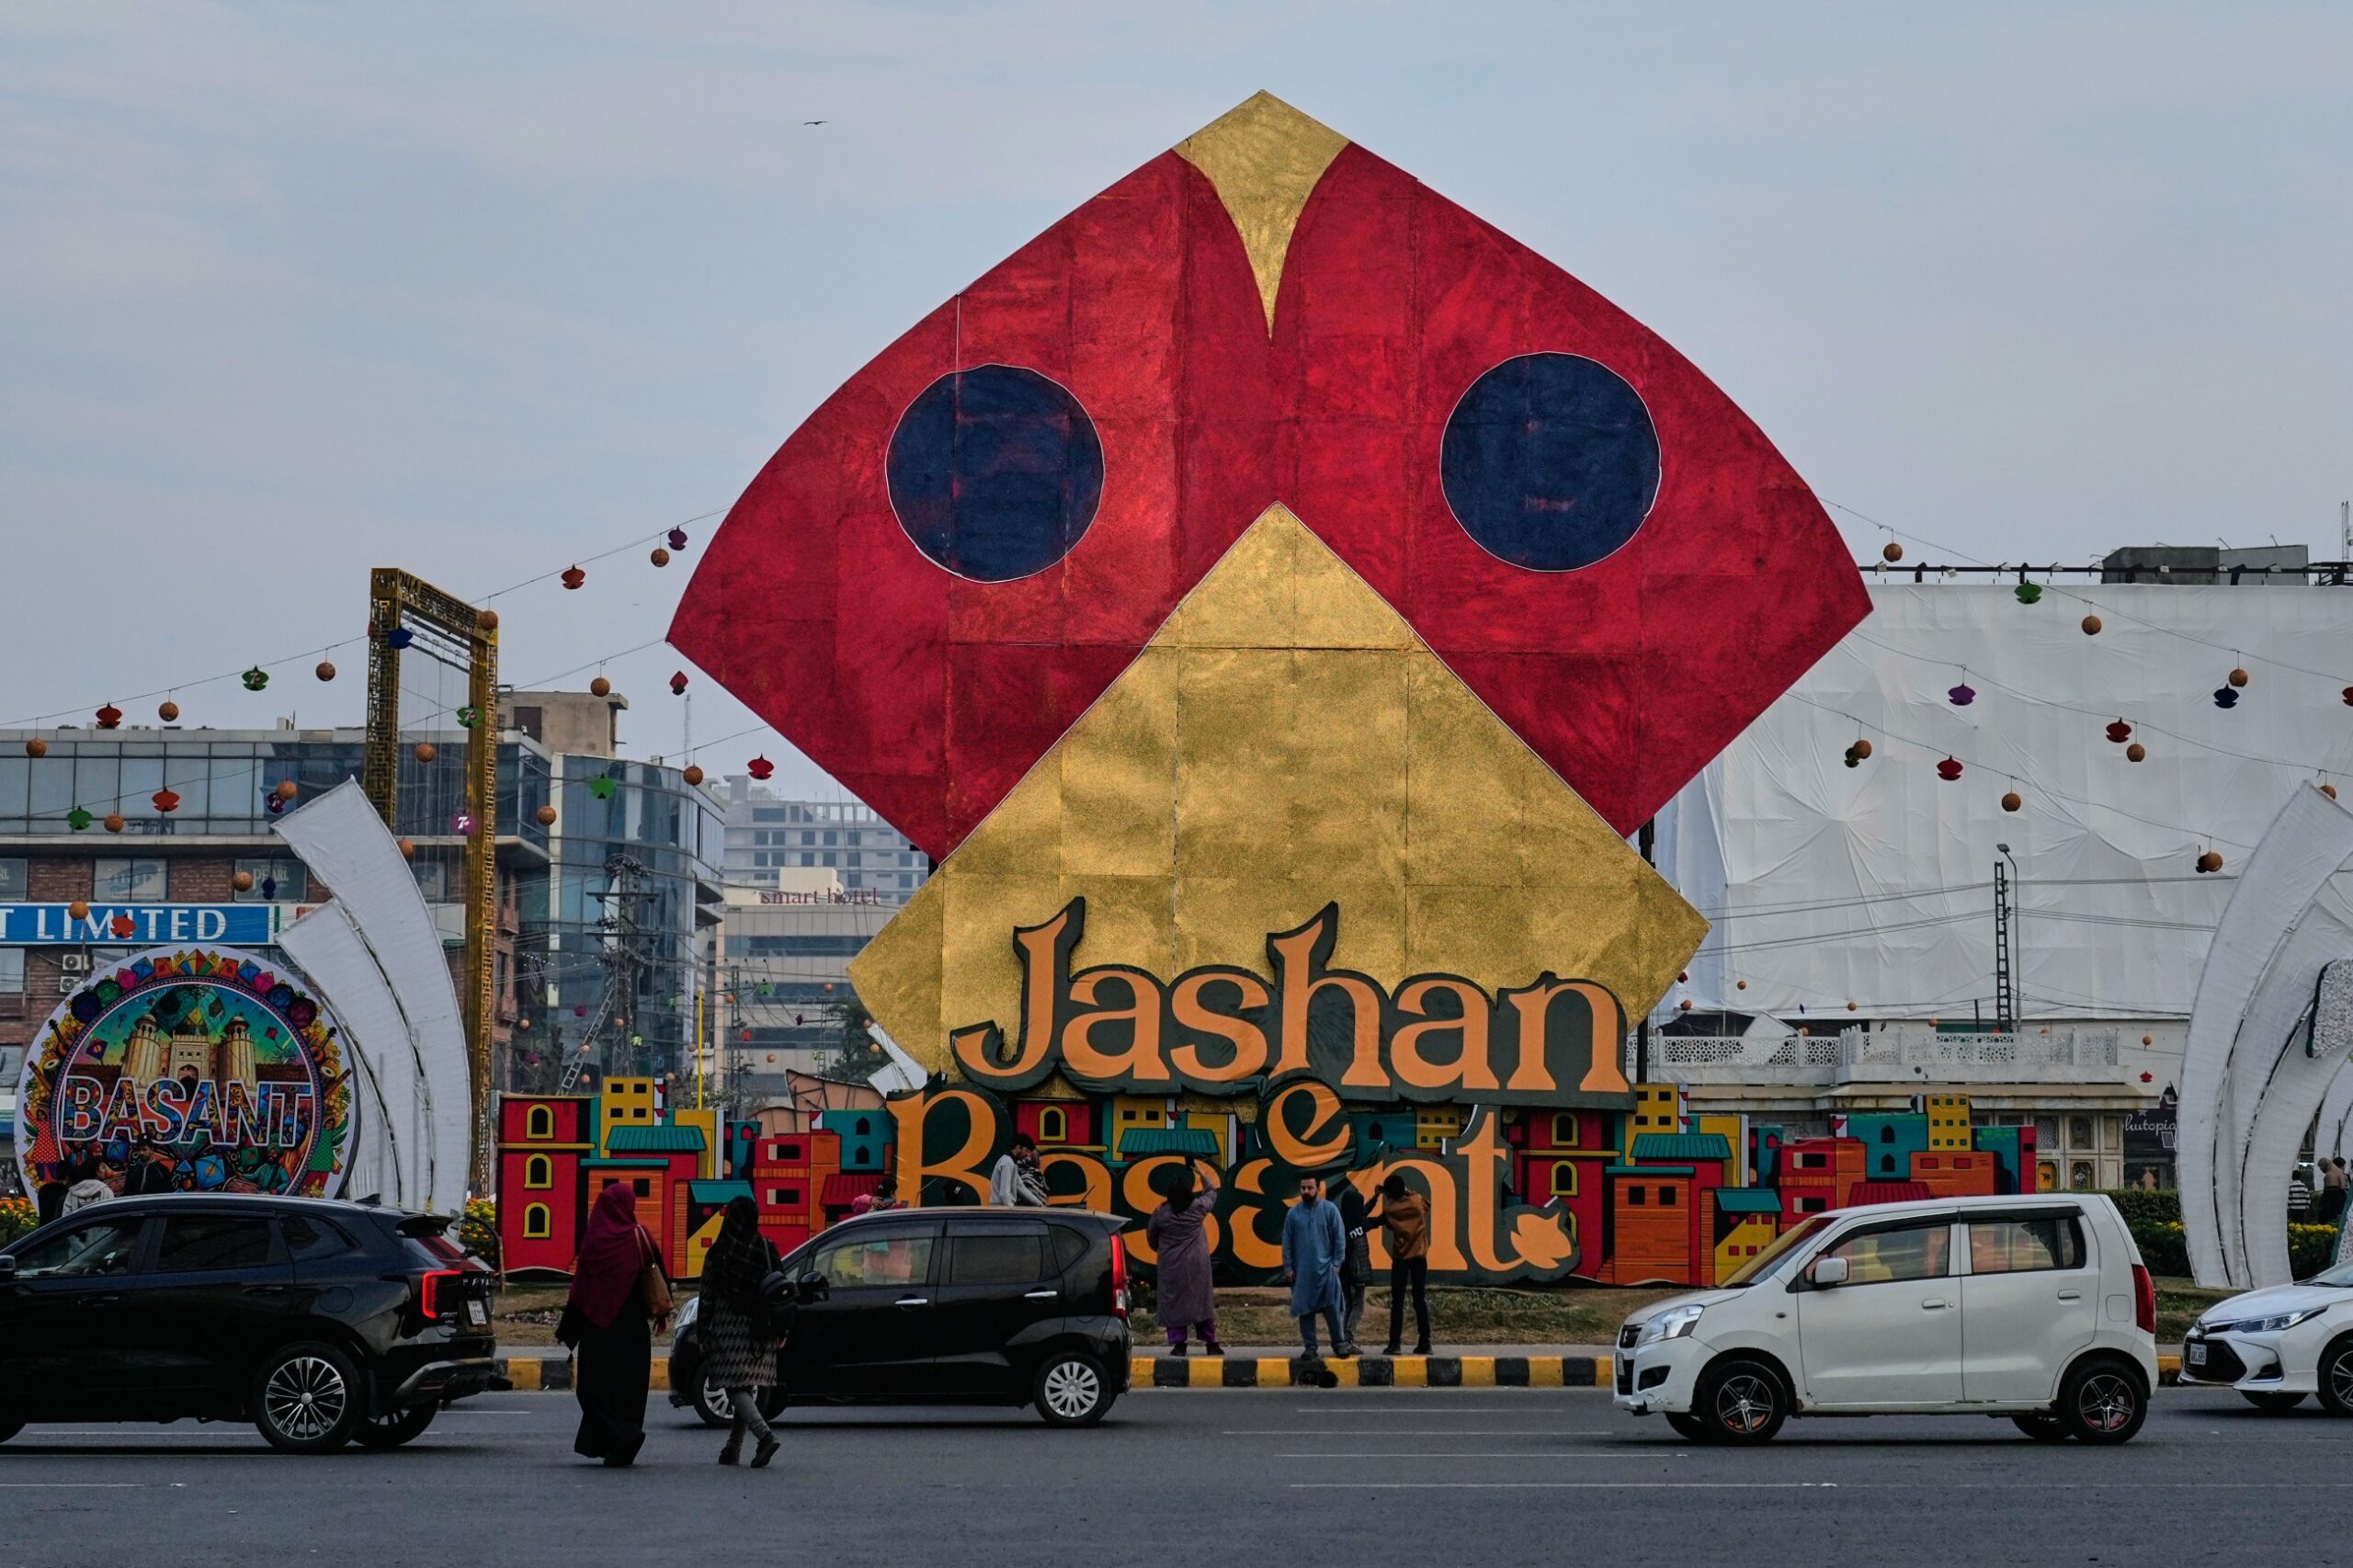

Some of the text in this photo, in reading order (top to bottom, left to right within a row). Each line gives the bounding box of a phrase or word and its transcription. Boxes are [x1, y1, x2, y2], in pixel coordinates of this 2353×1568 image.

[759, 887, 879, 905] smart hotel
[953, 910, 1630, 1092] Jashan
[58, 1075, 312, 1148] BASANT
